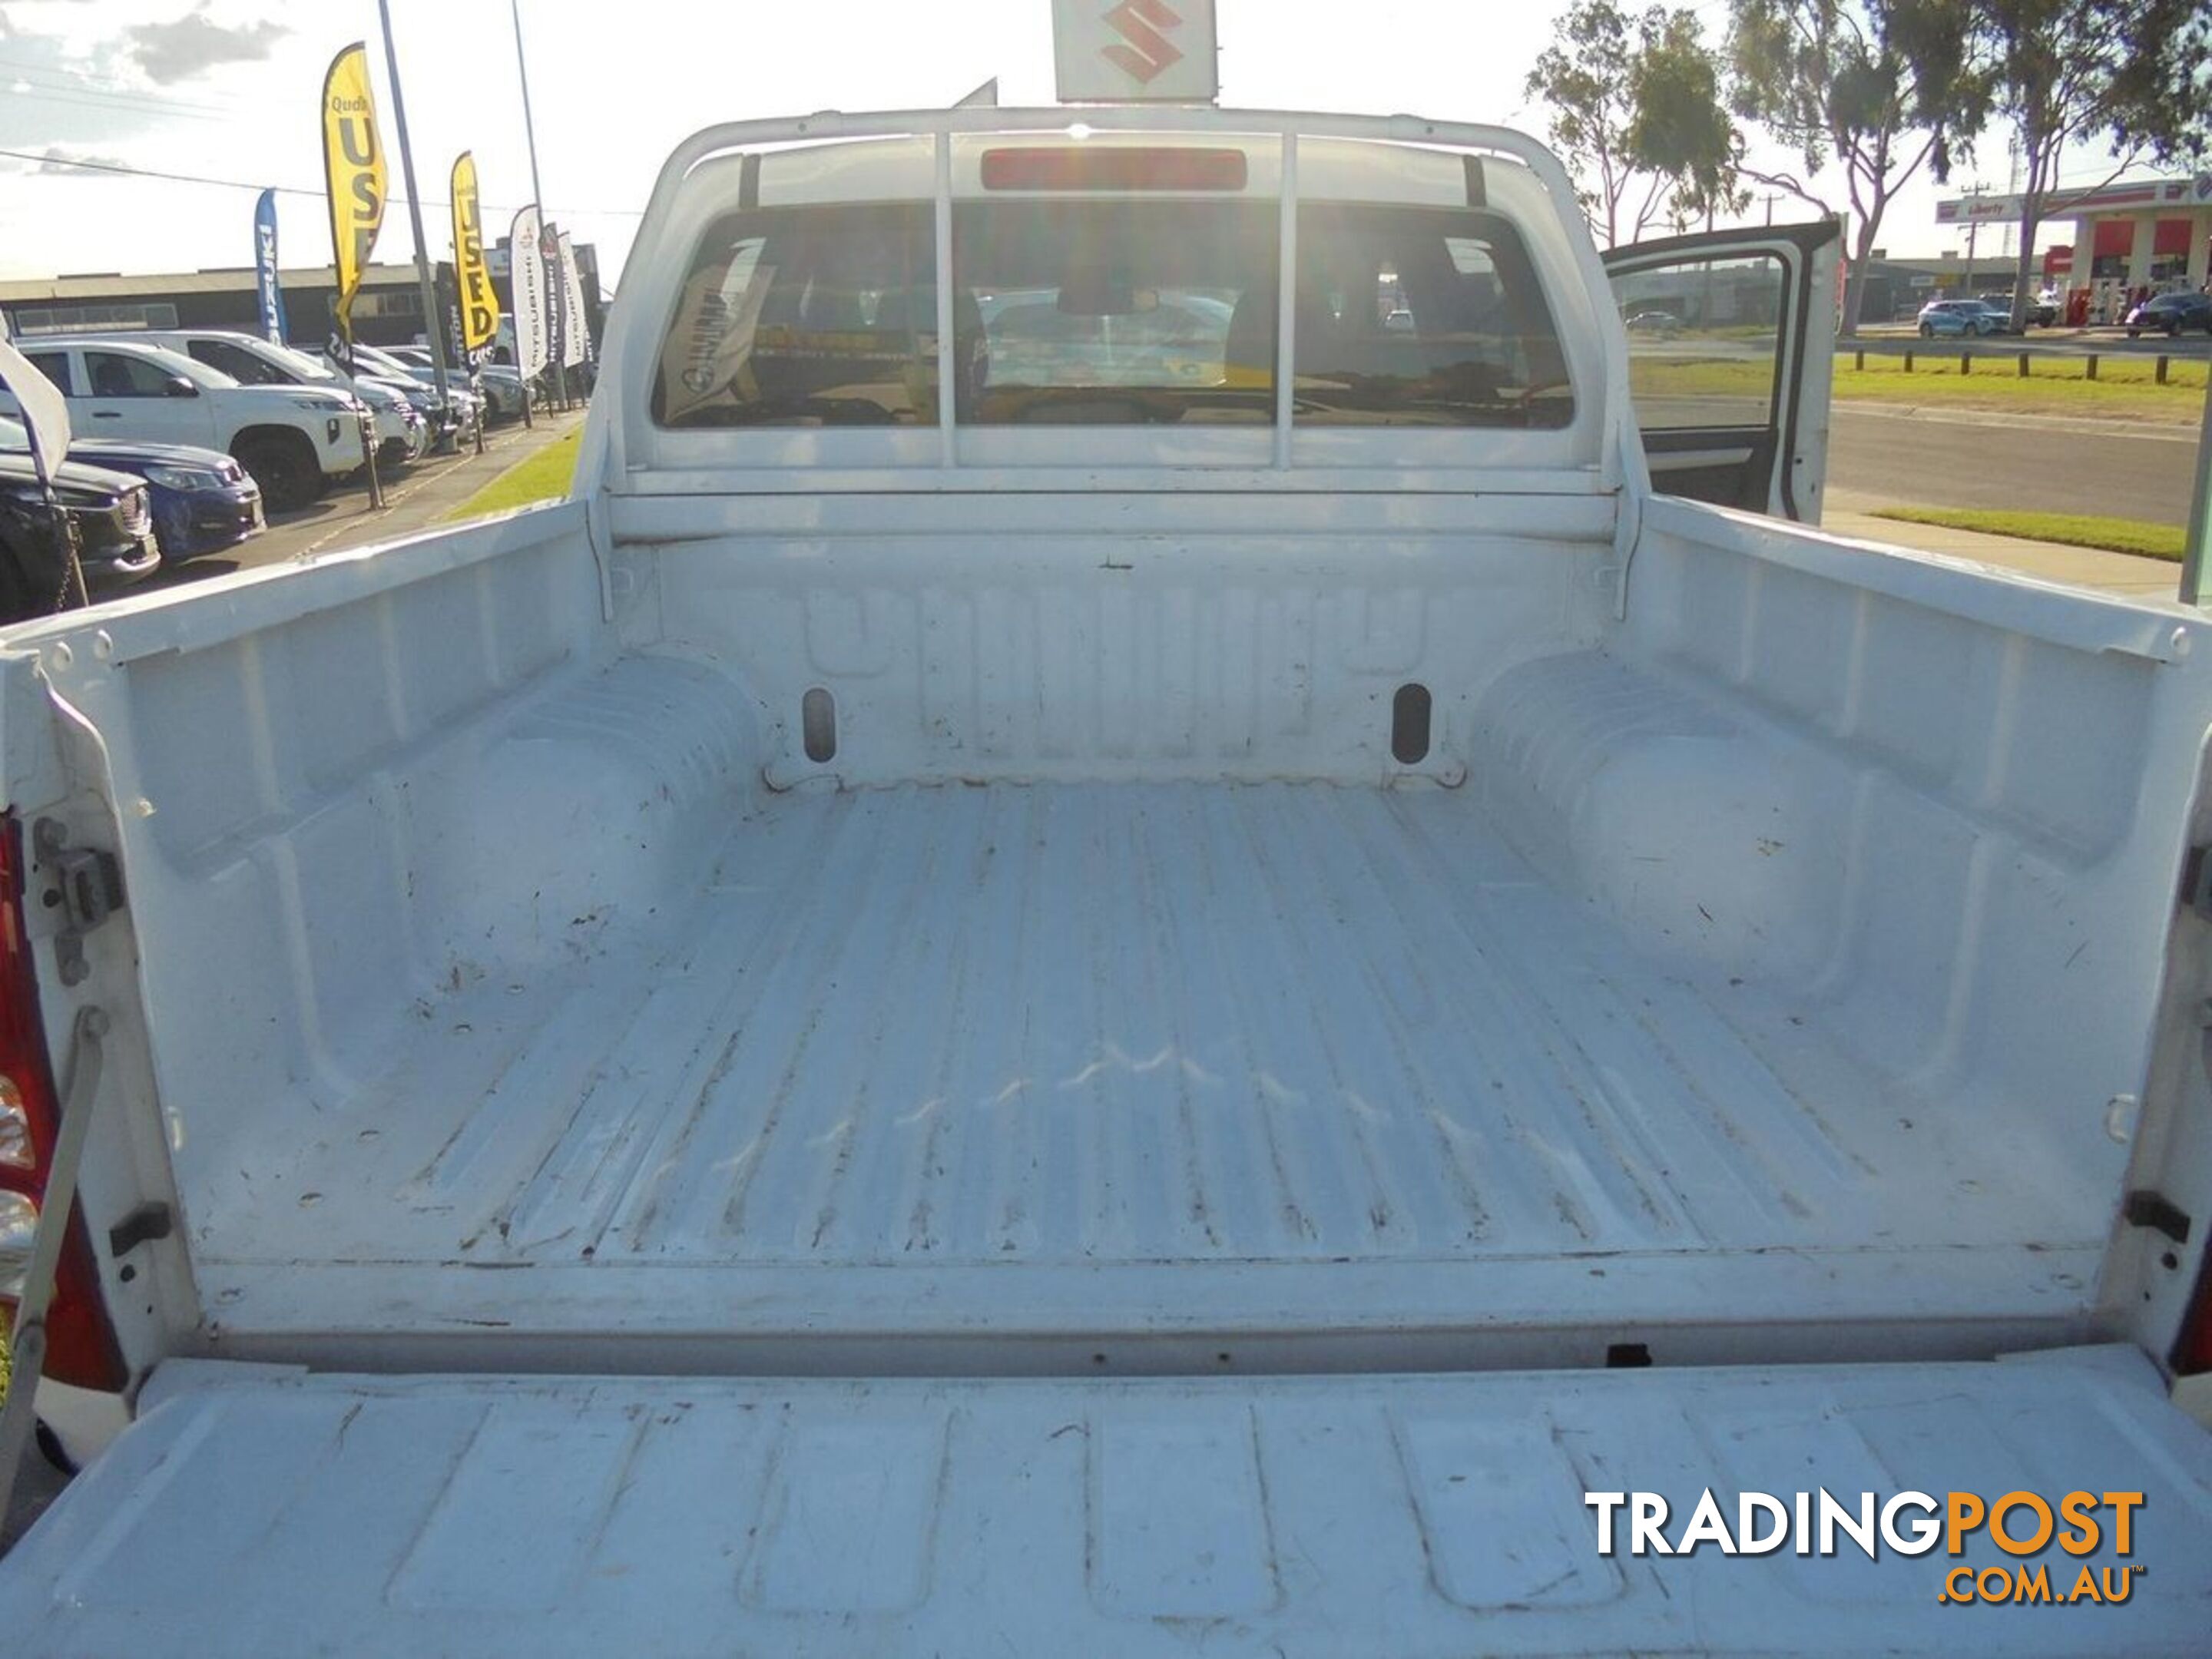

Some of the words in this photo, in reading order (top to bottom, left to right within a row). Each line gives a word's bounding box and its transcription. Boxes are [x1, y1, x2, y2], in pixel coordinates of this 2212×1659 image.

[1968, 203, 2004, 216] Liberty
[259, 224, 282, 346] SUZUKI
[459, 198, 493, 337] USED
[525, 255, 540, 367] MITSUBISHI
[547, 264, 558, 363] MITSUBISHI
